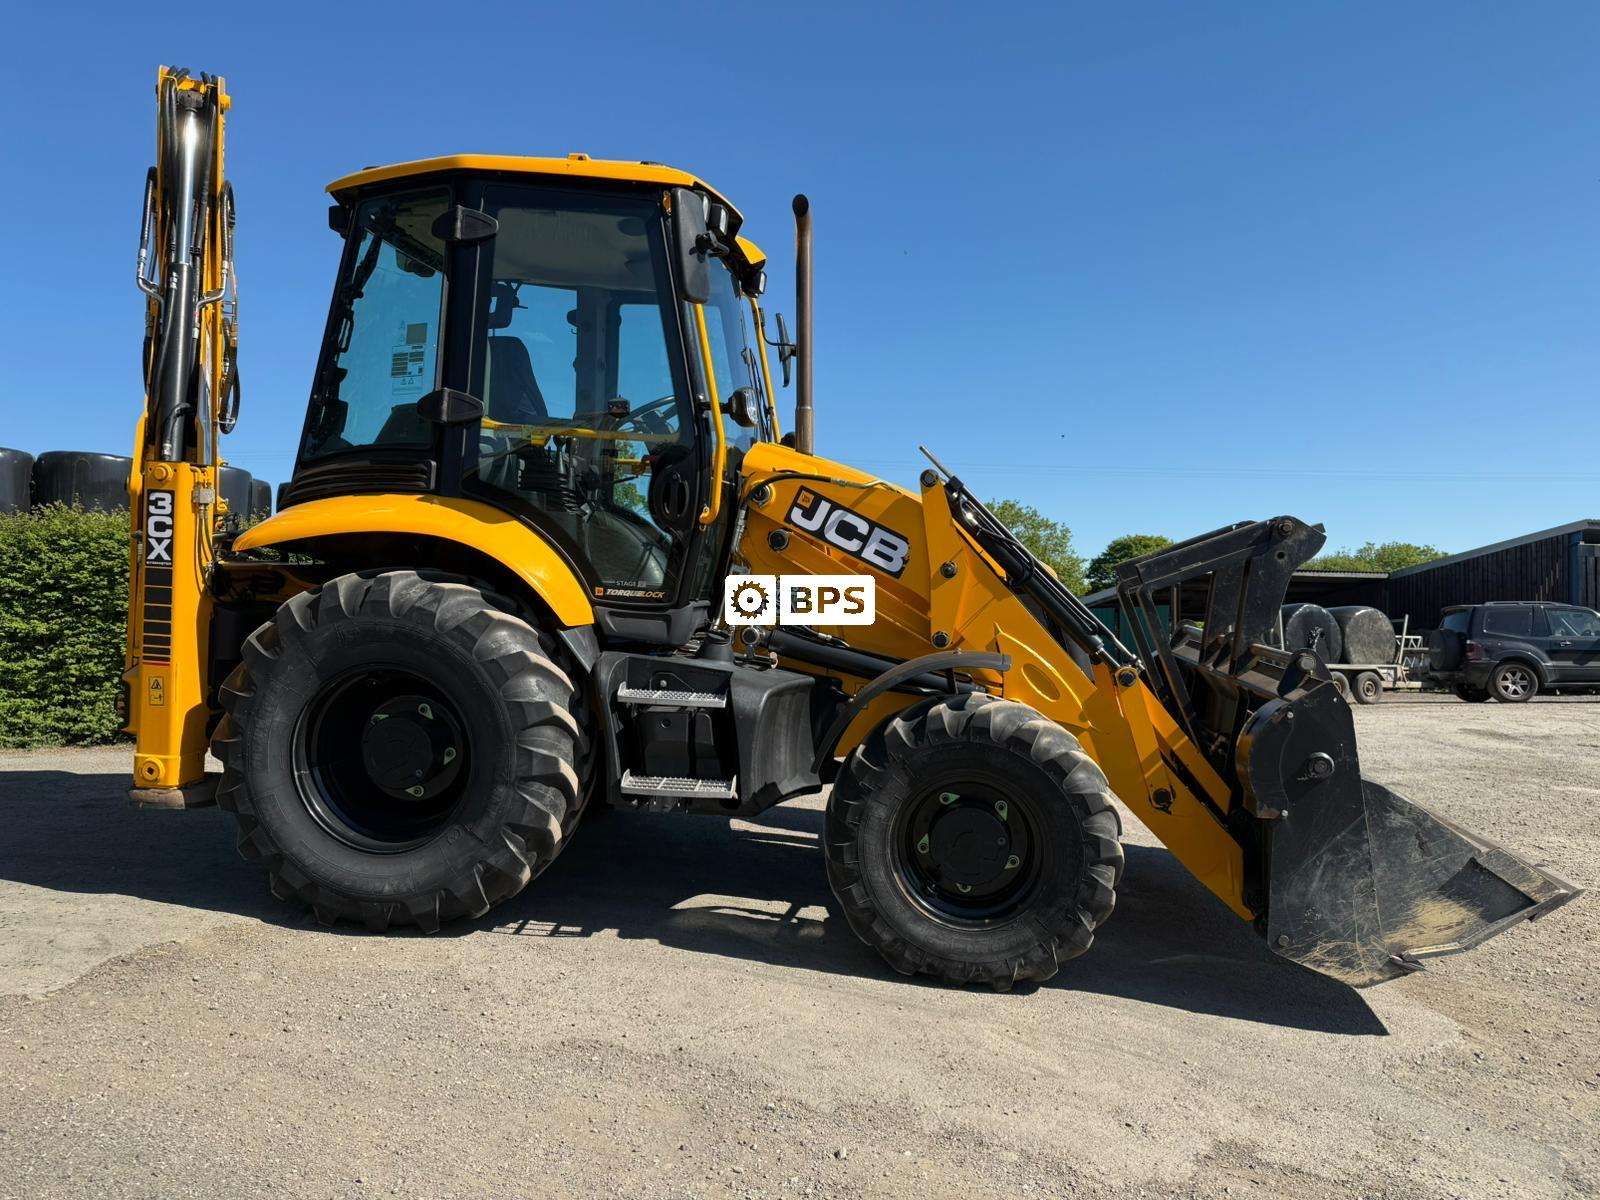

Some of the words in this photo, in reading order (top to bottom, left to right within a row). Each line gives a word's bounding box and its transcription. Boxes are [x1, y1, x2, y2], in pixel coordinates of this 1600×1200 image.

[147, 492, 172, 560] 3CX
[790, 499, 909, 573] JCB
[606, 588, 666, 599] TORQUELOCK
